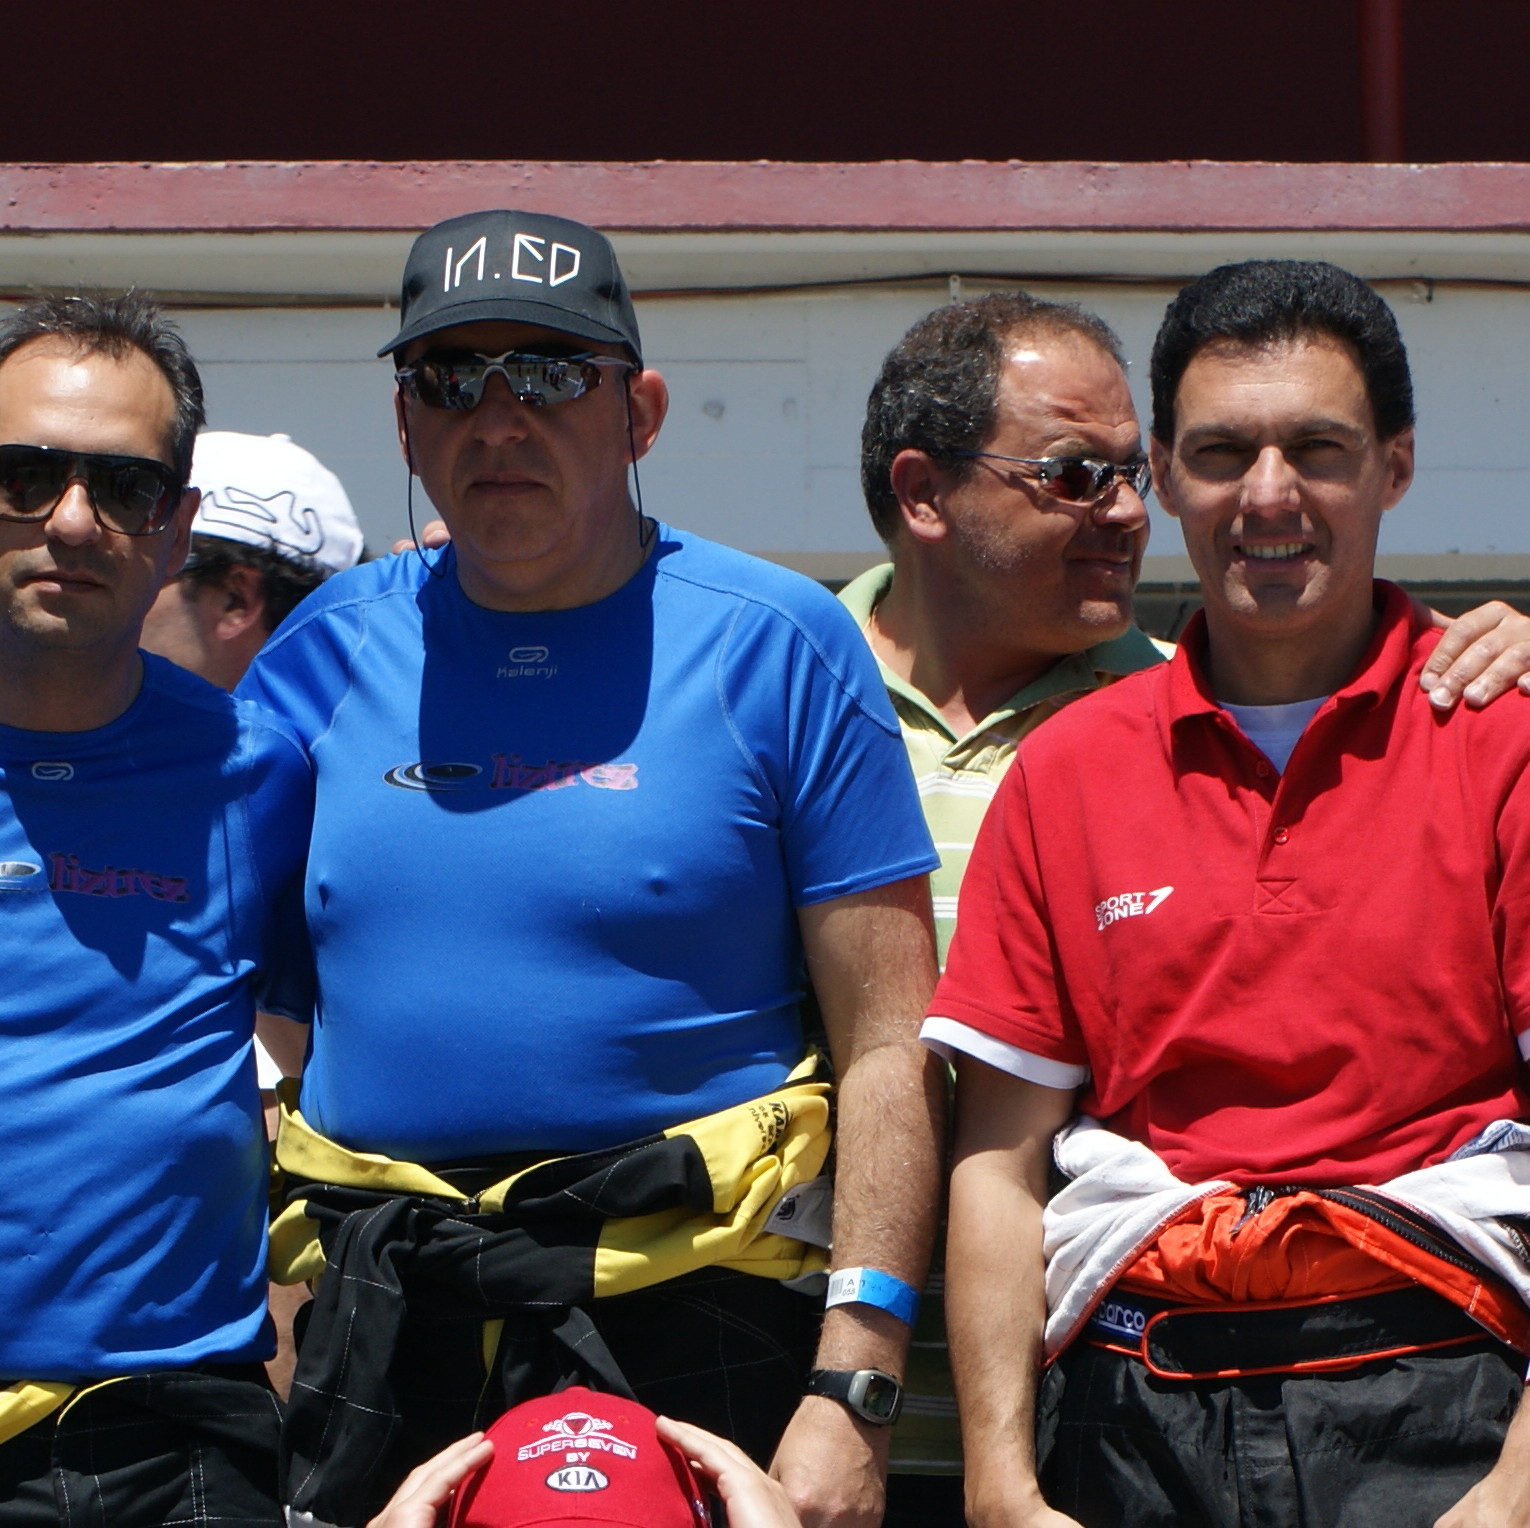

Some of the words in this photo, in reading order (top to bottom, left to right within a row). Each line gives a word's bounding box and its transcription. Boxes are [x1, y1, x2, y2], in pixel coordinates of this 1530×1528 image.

[496, 664, 558, 679] Kalenji
[1095, 892, 1146, 914] SPORT
[517, 1438, 637, 1460] SUPERSEVEN
[565, 1451, 590, 1462] BY
[557, 1470, 601, 1489] KIA
